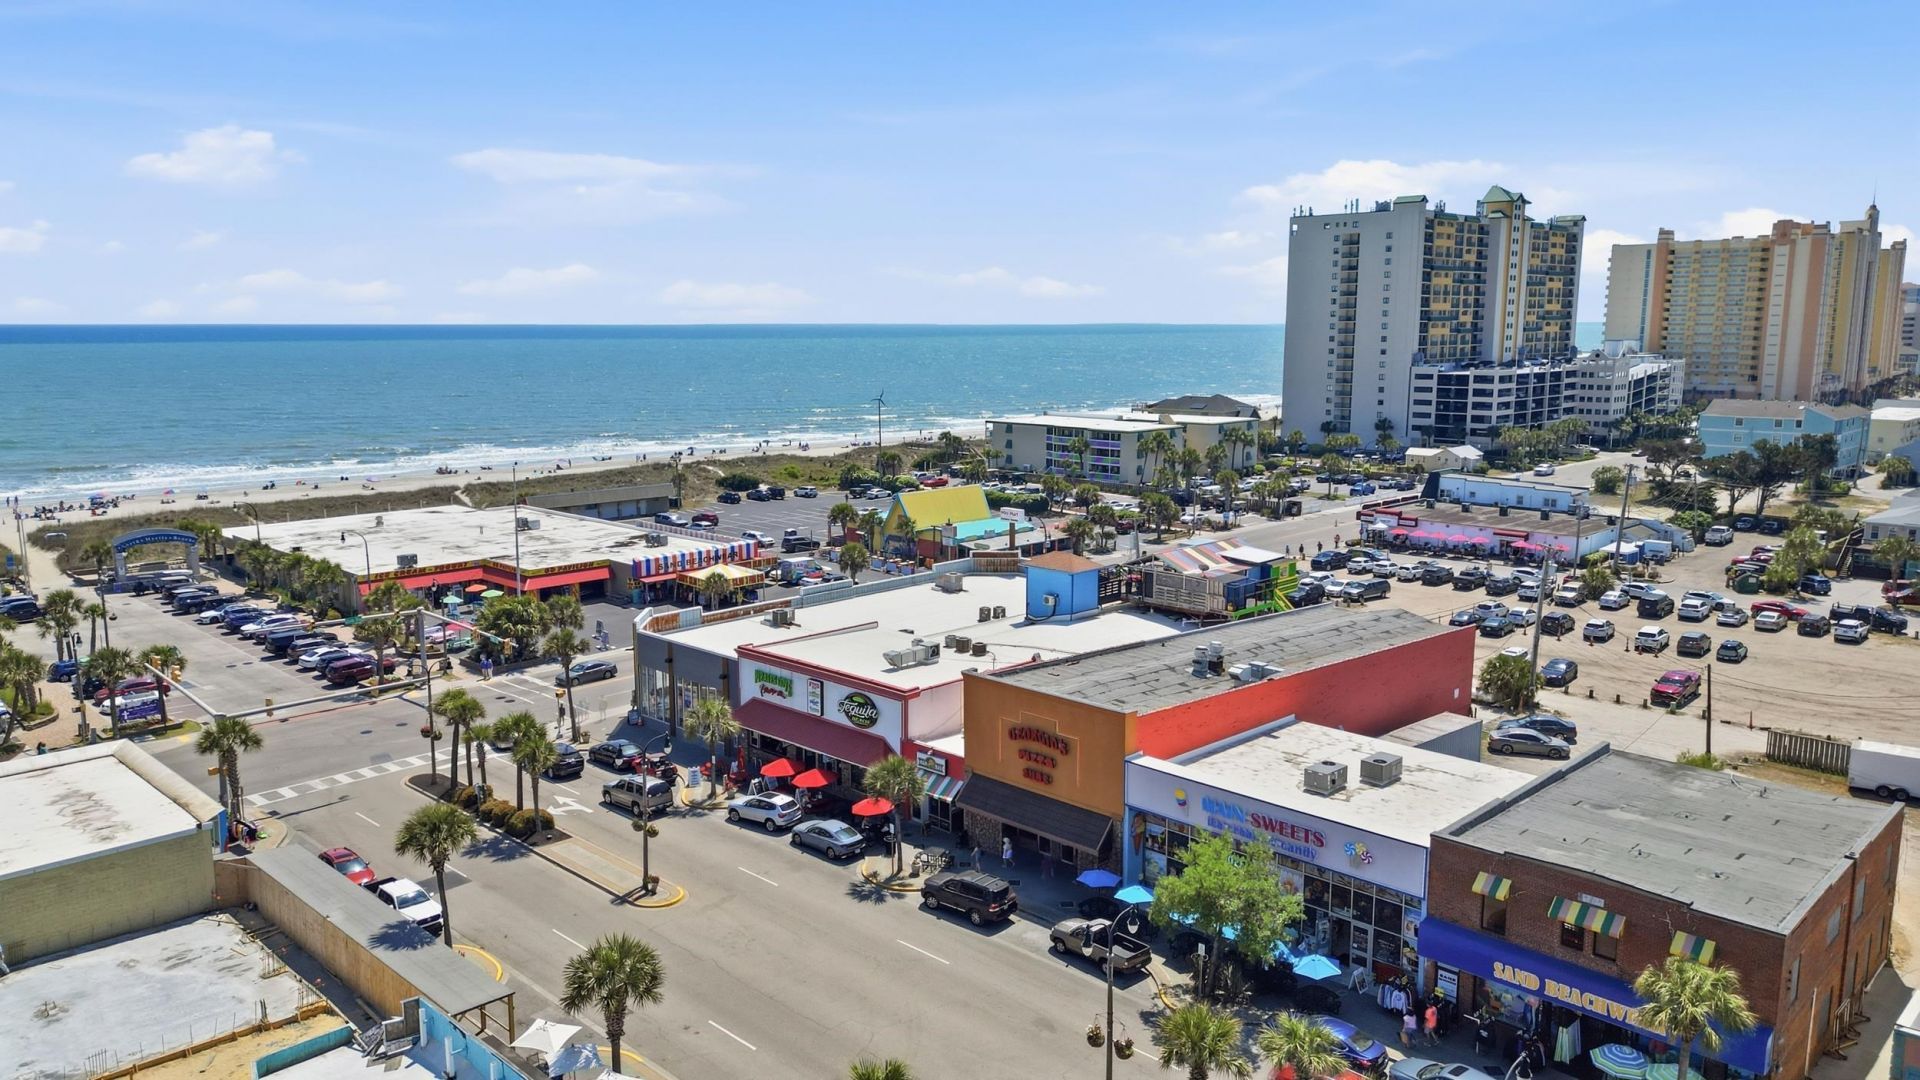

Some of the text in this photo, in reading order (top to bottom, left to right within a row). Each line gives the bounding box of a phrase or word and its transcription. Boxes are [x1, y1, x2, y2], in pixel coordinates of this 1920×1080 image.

[394, 567, 426, 577] CREAM
[658, 560, 682, 571] SAND
[837, 699, 879, 719] Tequila
[1250, 813, 1326, 847] SWEETS
[1493, 961, 1667, 1036] SAND BEACHWE
